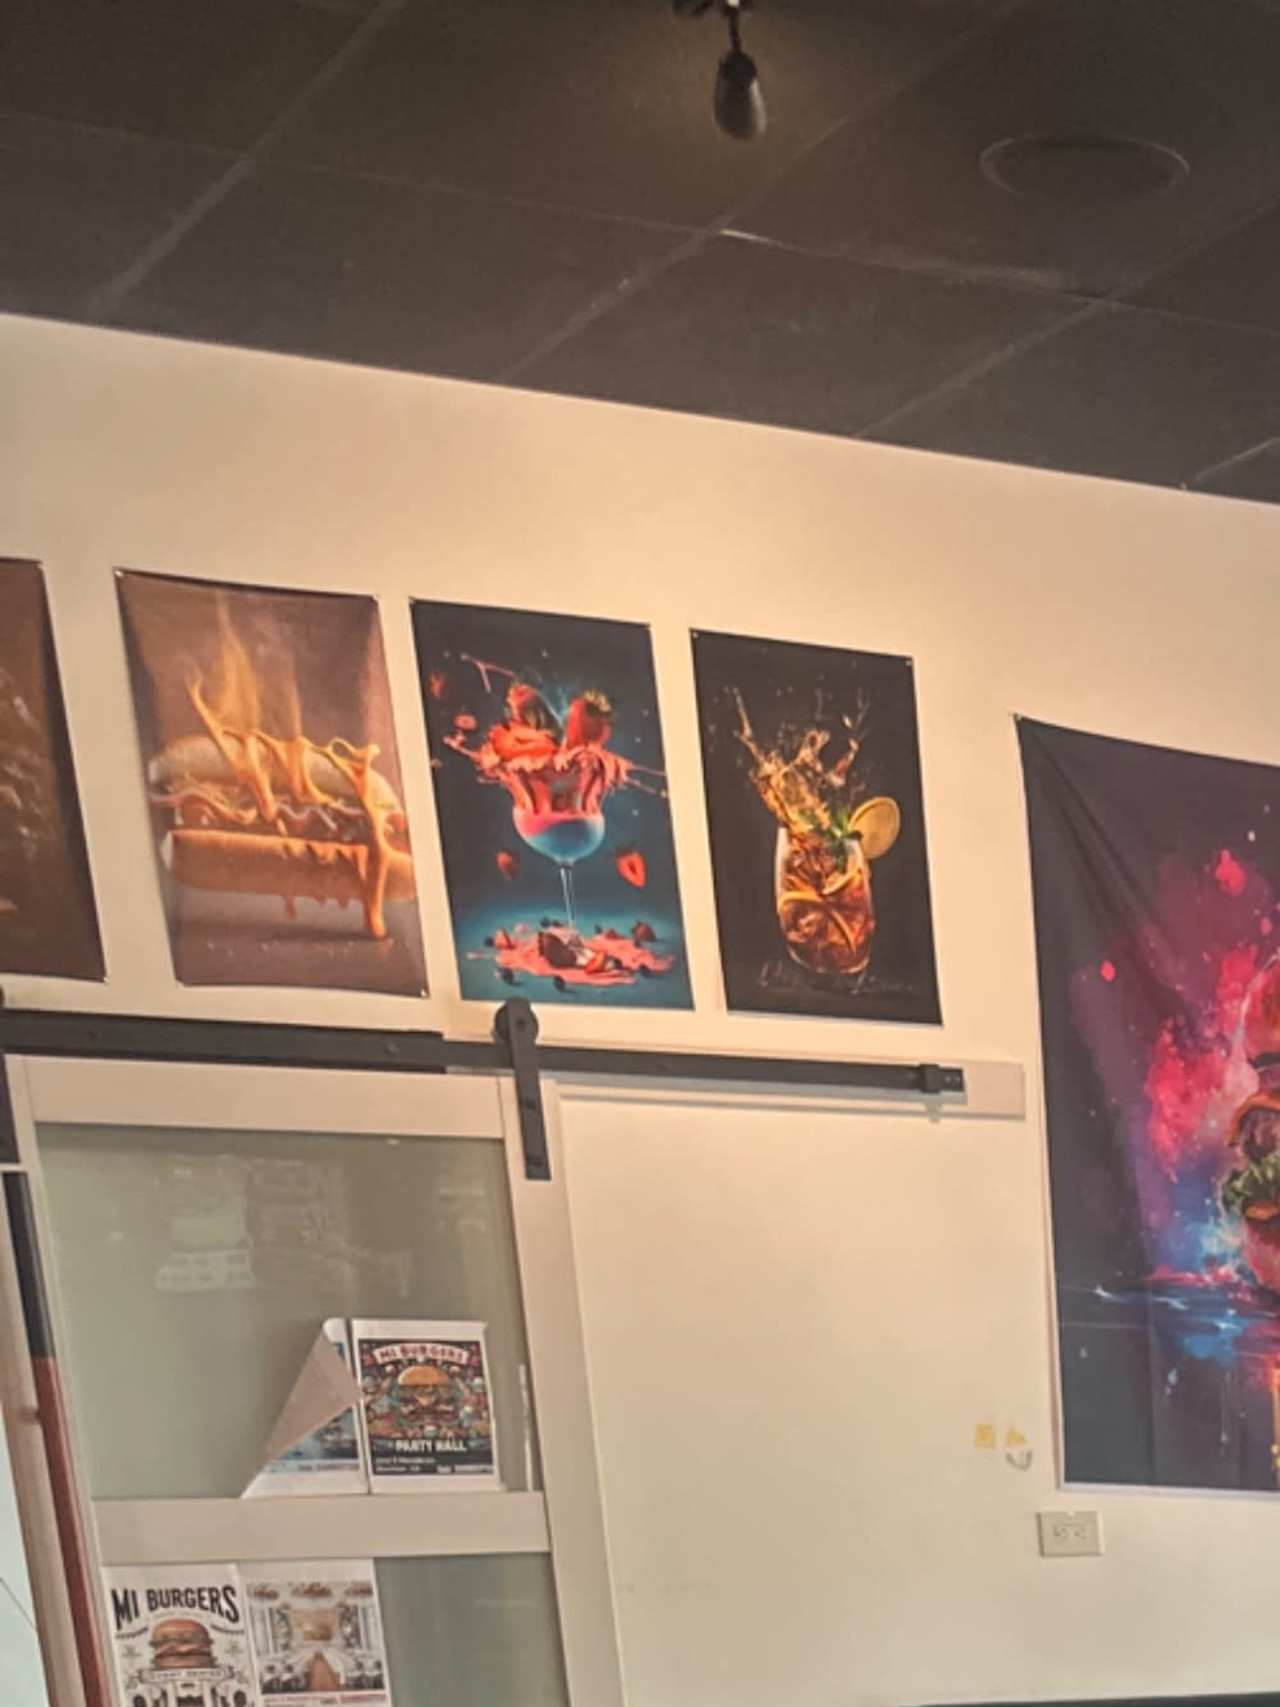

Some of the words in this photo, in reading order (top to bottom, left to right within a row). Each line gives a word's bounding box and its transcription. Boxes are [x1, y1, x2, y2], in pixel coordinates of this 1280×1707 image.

[395, 1439, 433, 1452] PARTY
[436, 1439, 468, 1452] HALL
[111, 1588, 139, 1631] MI
[146, 1584, 240, 1623] BURGERS
